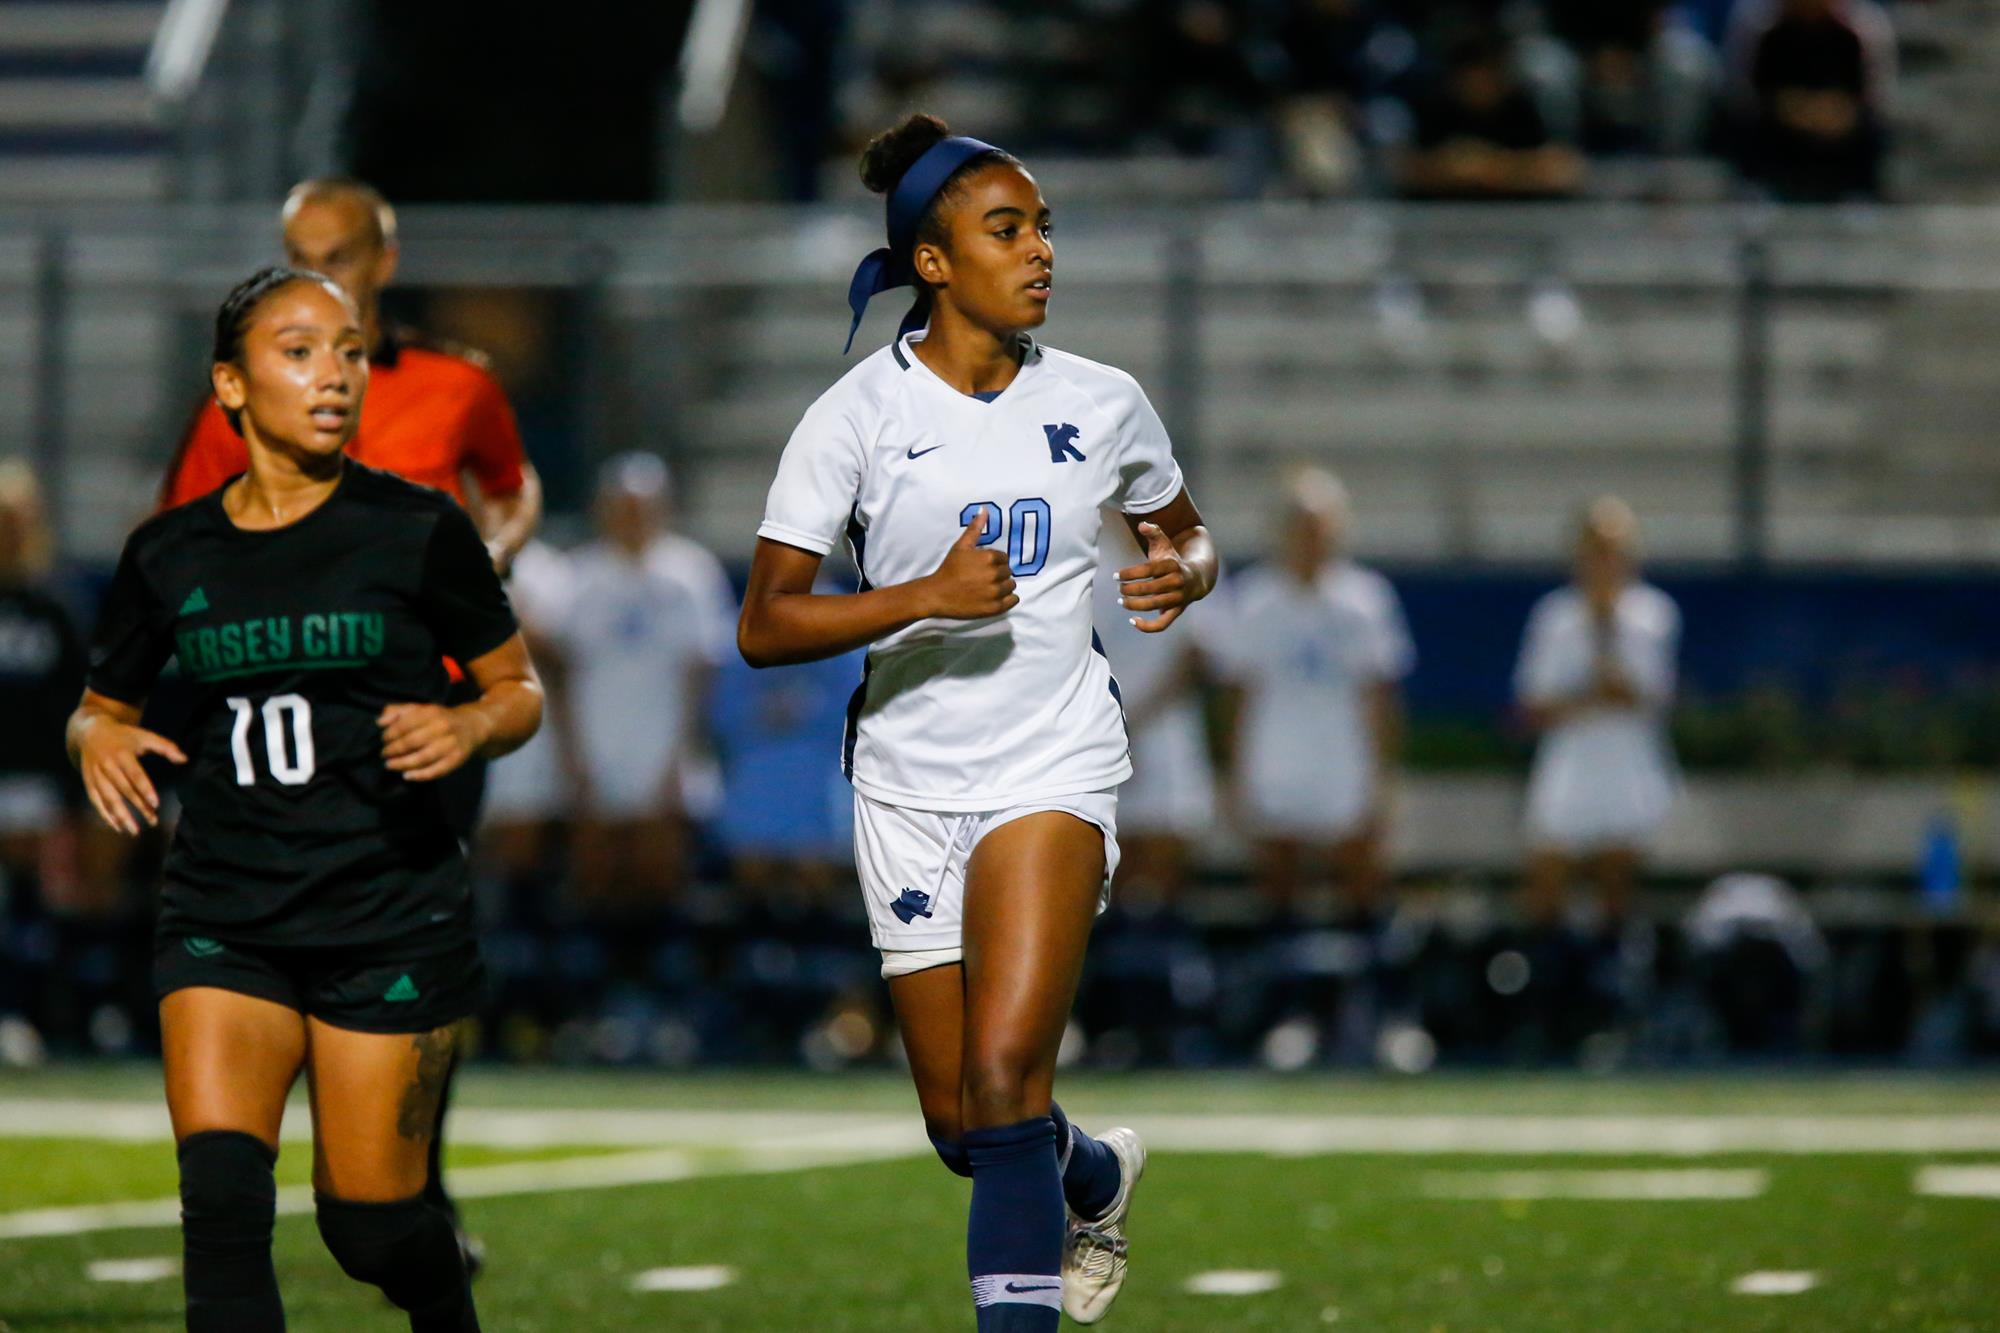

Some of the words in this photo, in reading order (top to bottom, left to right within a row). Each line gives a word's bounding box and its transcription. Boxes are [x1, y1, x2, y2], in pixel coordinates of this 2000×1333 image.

[175, 616, 292, 673] ERSEY
[303, 612, 385, 657] CITY
[226, 693, 315, 786] 10
